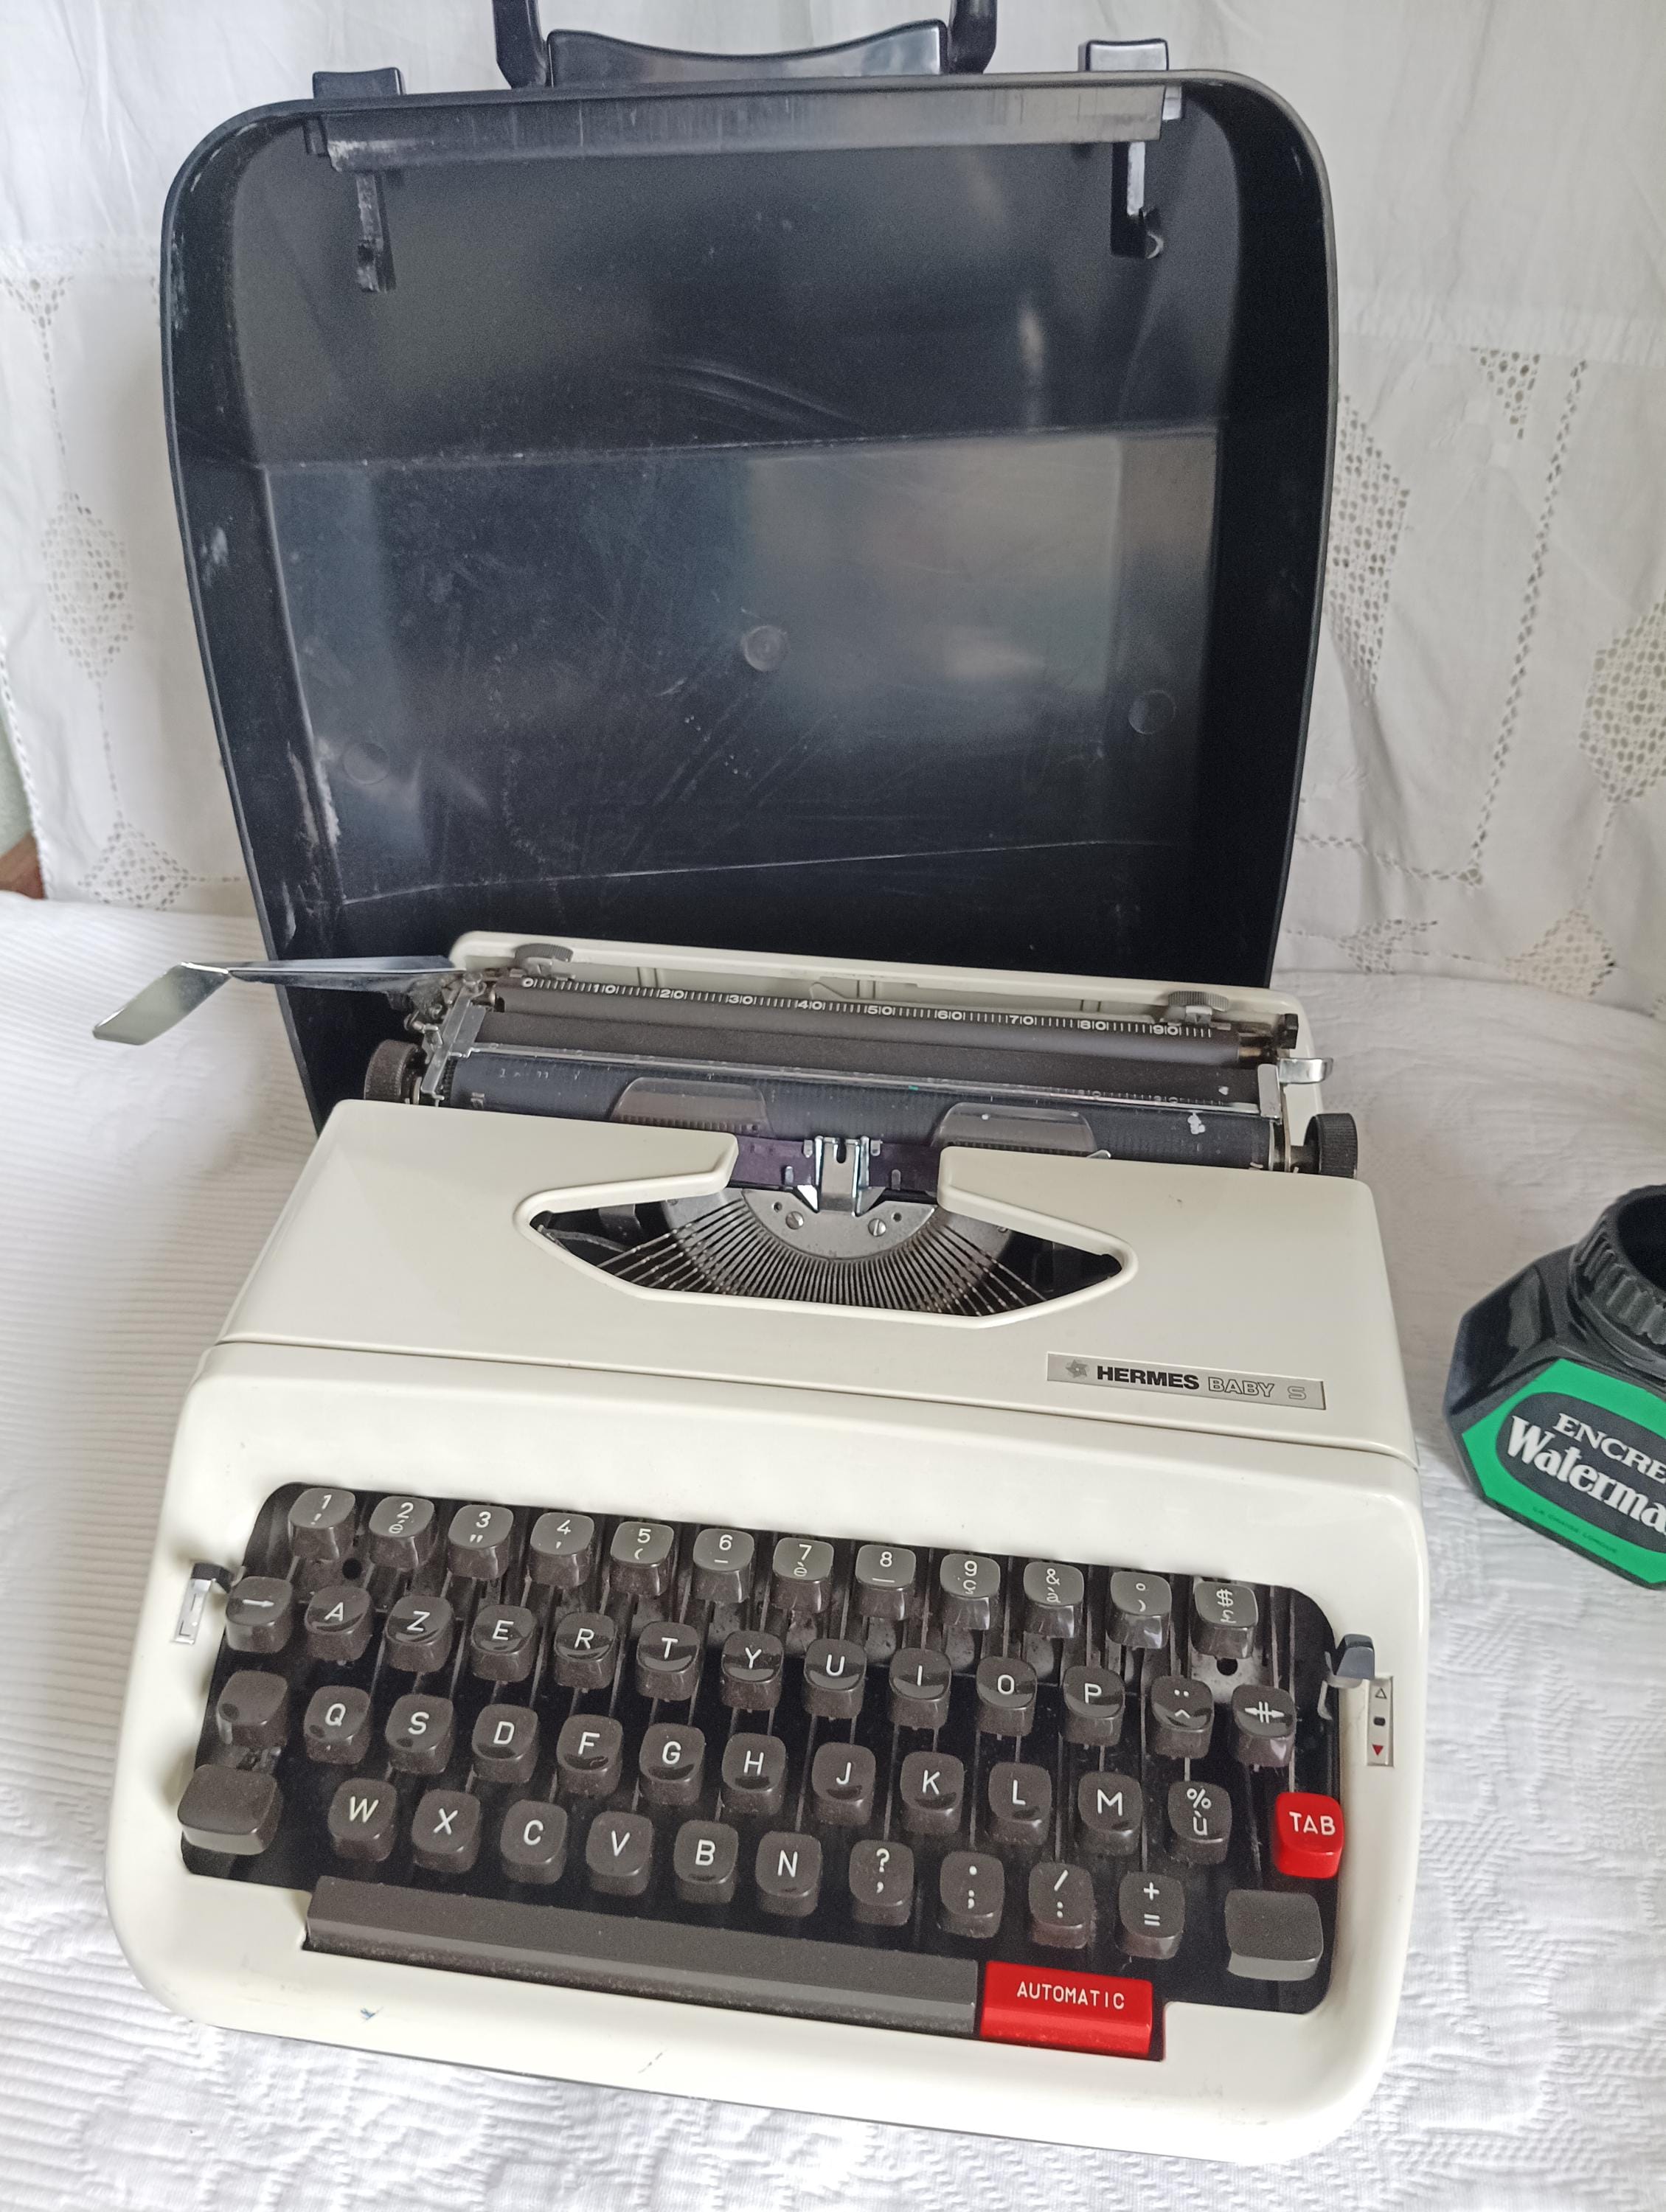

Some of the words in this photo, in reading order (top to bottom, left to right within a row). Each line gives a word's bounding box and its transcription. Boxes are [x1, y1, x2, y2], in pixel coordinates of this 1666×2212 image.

[592, 984, 616, 995] 10
[659, 990, 684, 999] 20
[728, 994, 753, 1005] 30
[798, 1000, 822, 1010] 40
[867, 1006, 892, 1015] 50
[937, 1010, 962, 1020] 60
[1010, 1015, 1034, 1026] 70
[1080, 1020, 1106, 1031] 80
[1153, 1024, 1179, 1035] 90
[1097, 1366, 1199, 1390] HERMES
[1208, 1377, 1274, 1397] BABY
[1288, 1386, 1307, 1400] S
[1552, 1413, 1666, 1484] ENCRE
[322, 1494, 332, 1509] 1
[397, 1502, 414, 1518] 2
[476, 1512, 491, 1527] 3
[556, 1520, 572, 1535] 4
[637, 1528, 651, 1543] 5
[719, 1534, 732, 1551] 6
[799, 1544, 812, 1560] 7
[880, 1552, 893, 1567] 8
[964, 1561, 978, 1576] 9
[1046, 1568, 1061, 1585] &
[1217, 1588, 1234, 1607] $
[323, 1601, 345, 1621] A
[407, 1610, 430, 1632] Z
[492, 1620, 514, 1641] E
[574, 1628, 594, 1649] R
[661, 1637, 678, 1659] T
[745, 1647, 762, 1669] Y
[827, 1655, 844, 1676] U
[1084, 1683, 1102, 1703] P
[324, 1703, 346, 1727] Q
[408, 1712, 430, 1735] S
[493, 1721, 515, 1745] D
[578, 1732, 600, 1755] F
[662, 1742, 681, 1764] G
[743, 1750, 764, 1775] H
[836, 1762, 851, 1785] J
[922, 1770, 940, 1795] K
[1012, 1780, 1026, 1806] L
[1097, 1789, 1123, 1816] M
[1186, 1787, 1212, 1810] %
[349, 1796, 379, 1823] W
[433, 1808, 458, 1834] X
[523, 1820, 544, 1846] C
[1288, 1811, 1336, 1836] TAB
[611, 1830, 631, 1857] V
[695, 1840, 715, 1866] B
[777, 1850, 798, 1877] N
[876, 1848, 889, 1873] ?
[1017, 1981, 1125, 2009] AUTOMATIC
